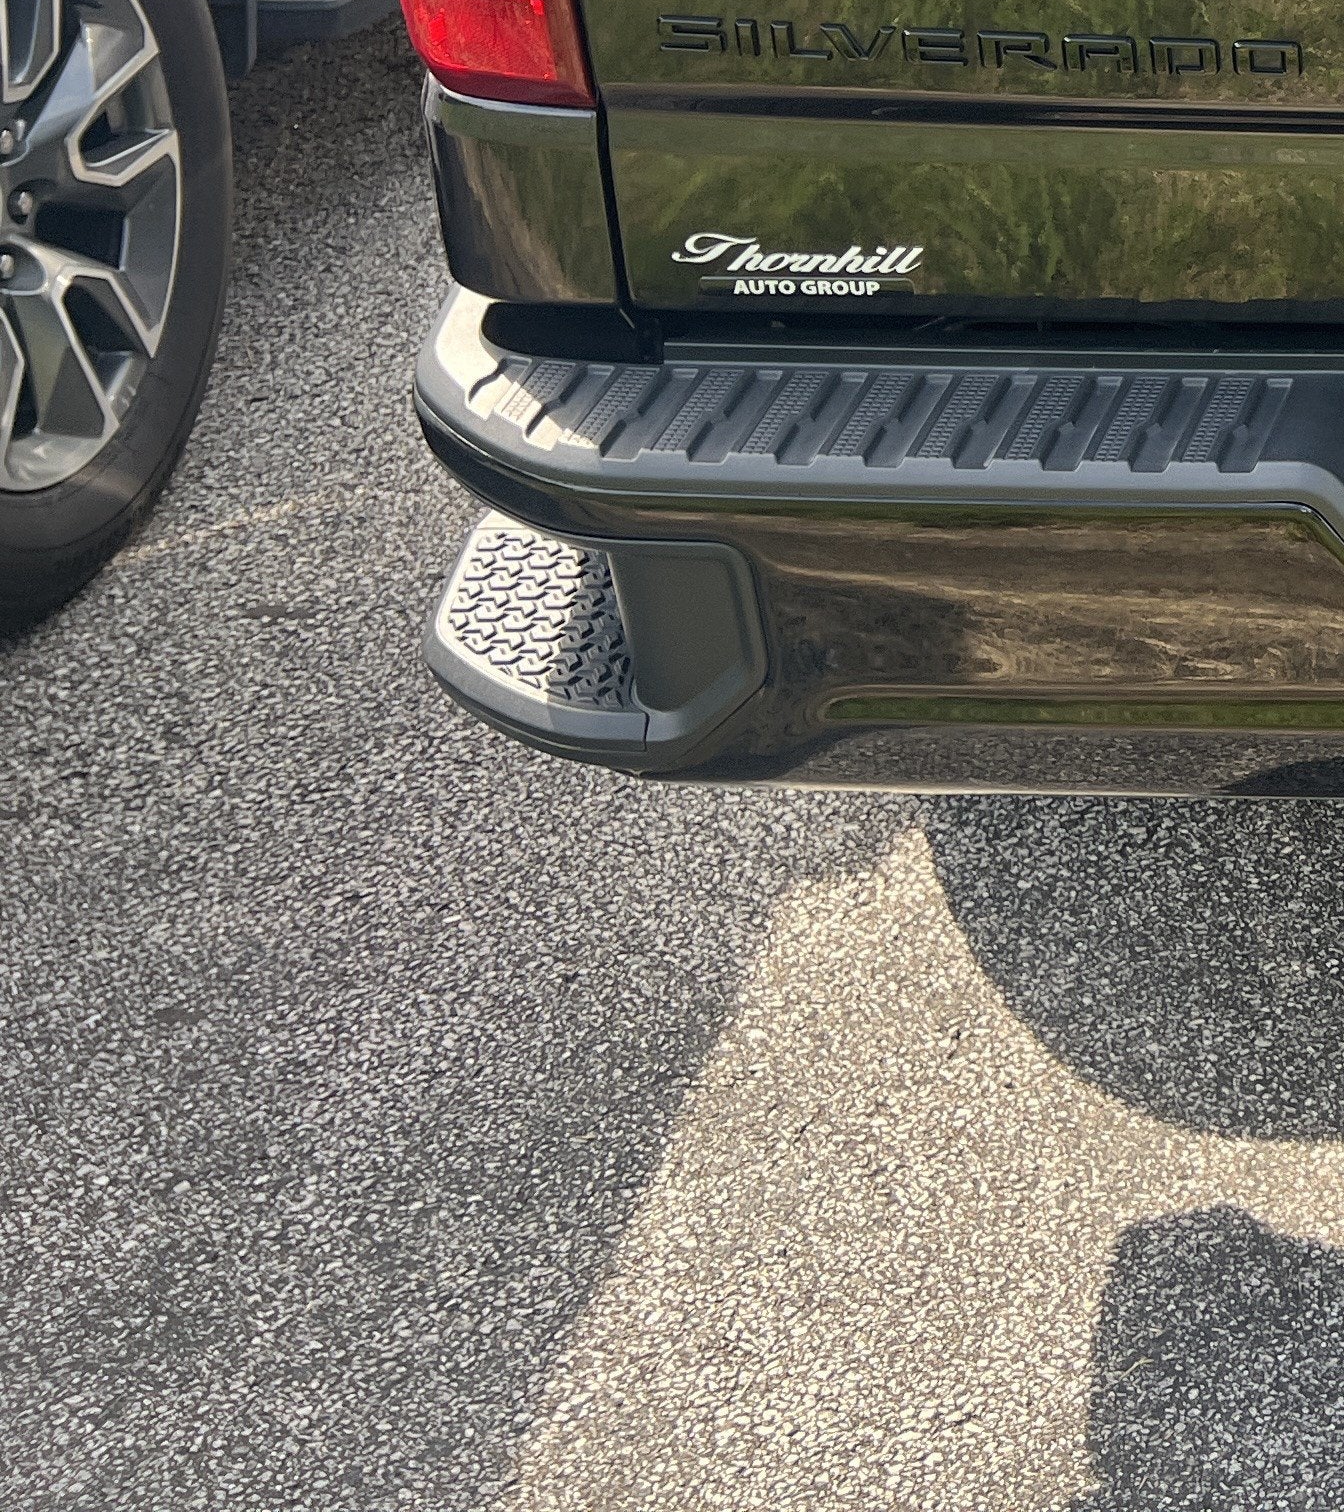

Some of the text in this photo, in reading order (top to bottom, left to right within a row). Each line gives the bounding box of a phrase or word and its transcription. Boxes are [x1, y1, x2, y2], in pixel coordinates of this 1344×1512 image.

[656, 14, 1303, 77] SILVERADO
[671, 232, 924, 274] Thornhill
[733, 278, 881, 296] AUTO GROUP
